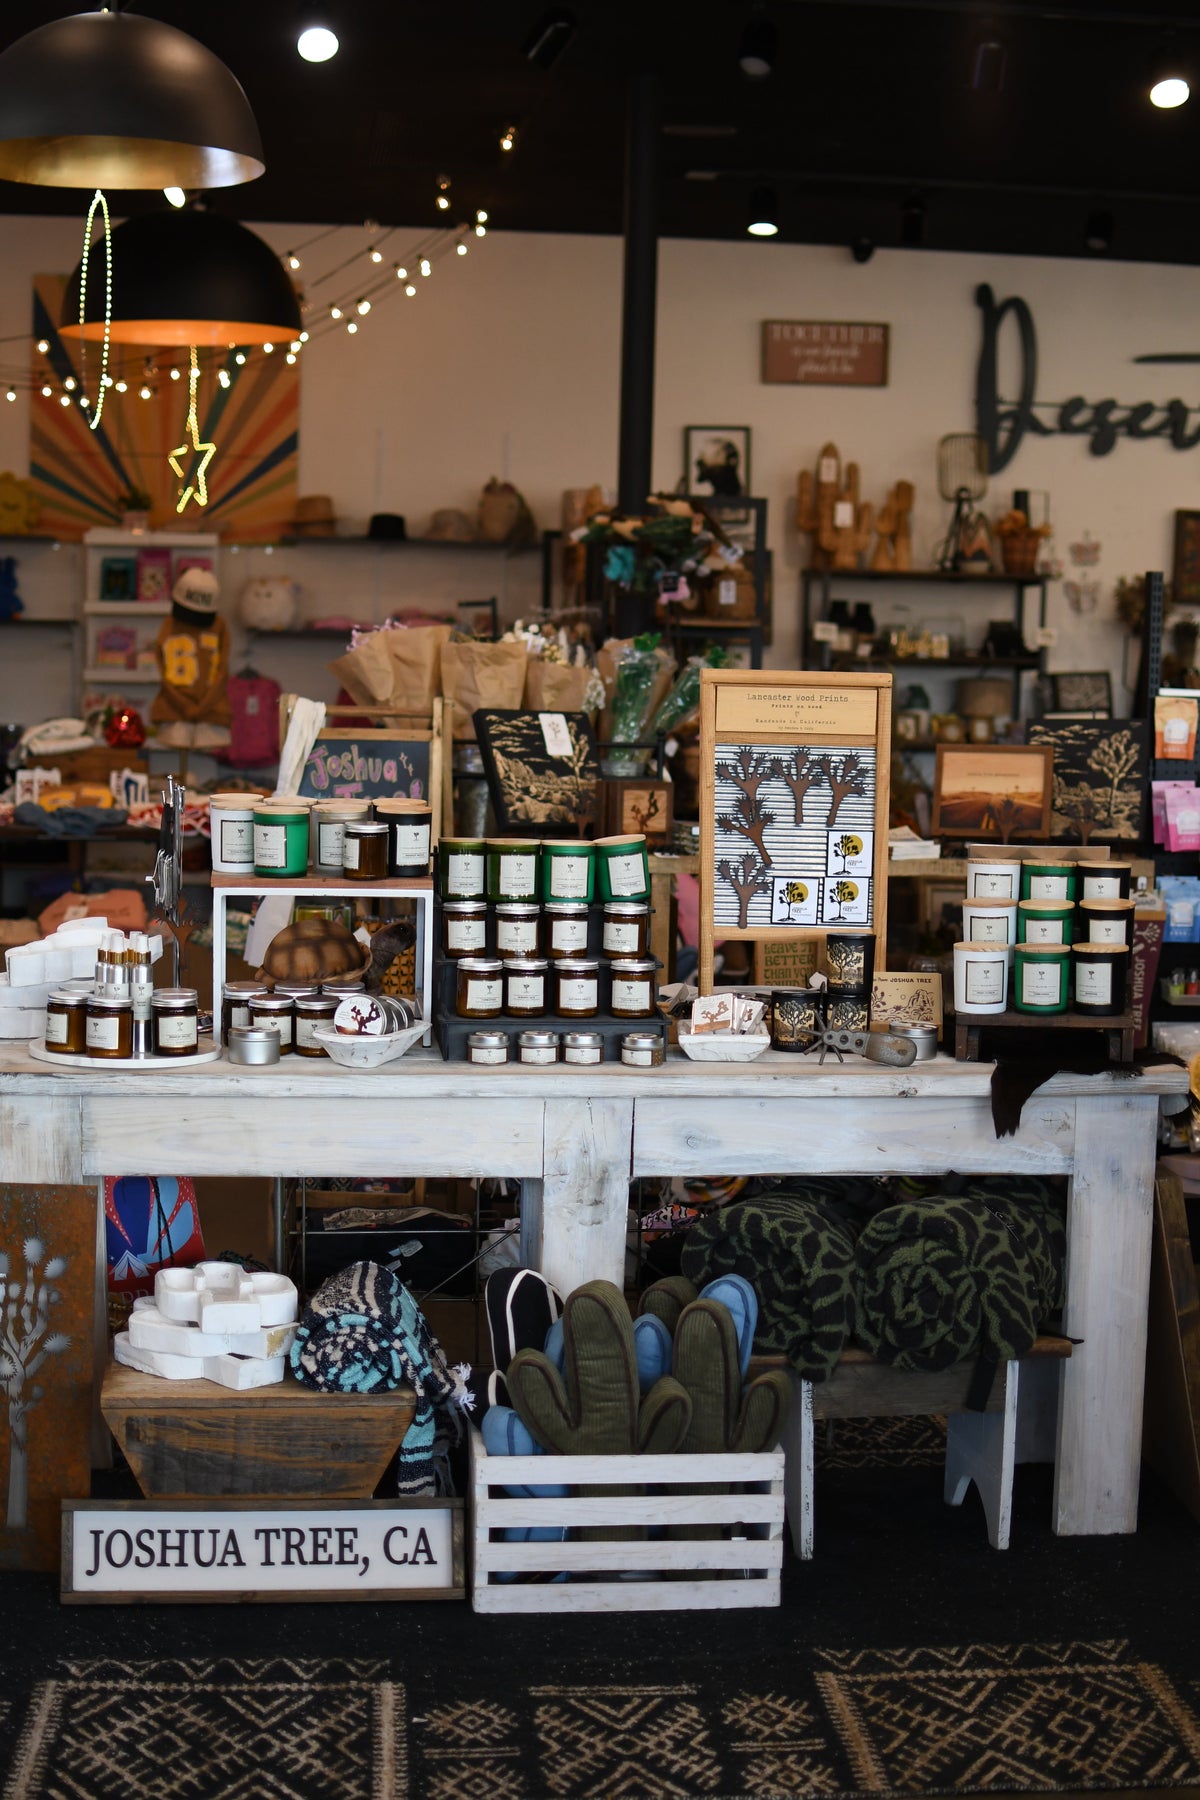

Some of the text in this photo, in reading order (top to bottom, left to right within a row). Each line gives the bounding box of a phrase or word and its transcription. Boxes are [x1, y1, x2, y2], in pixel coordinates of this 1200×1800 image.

[974, 282, 1200, 476] Deser
[747, 693, 792, 701] Lancaster
[819, 694, 849, 702] Prints
[306, 744, 398, 790] Joshua
[765, 955, 814, 966] BETTER
[1132, 957, 1146, 999] JOSHUA
[85, 1526, 438, 1577] JOSHUA TREE, CA
